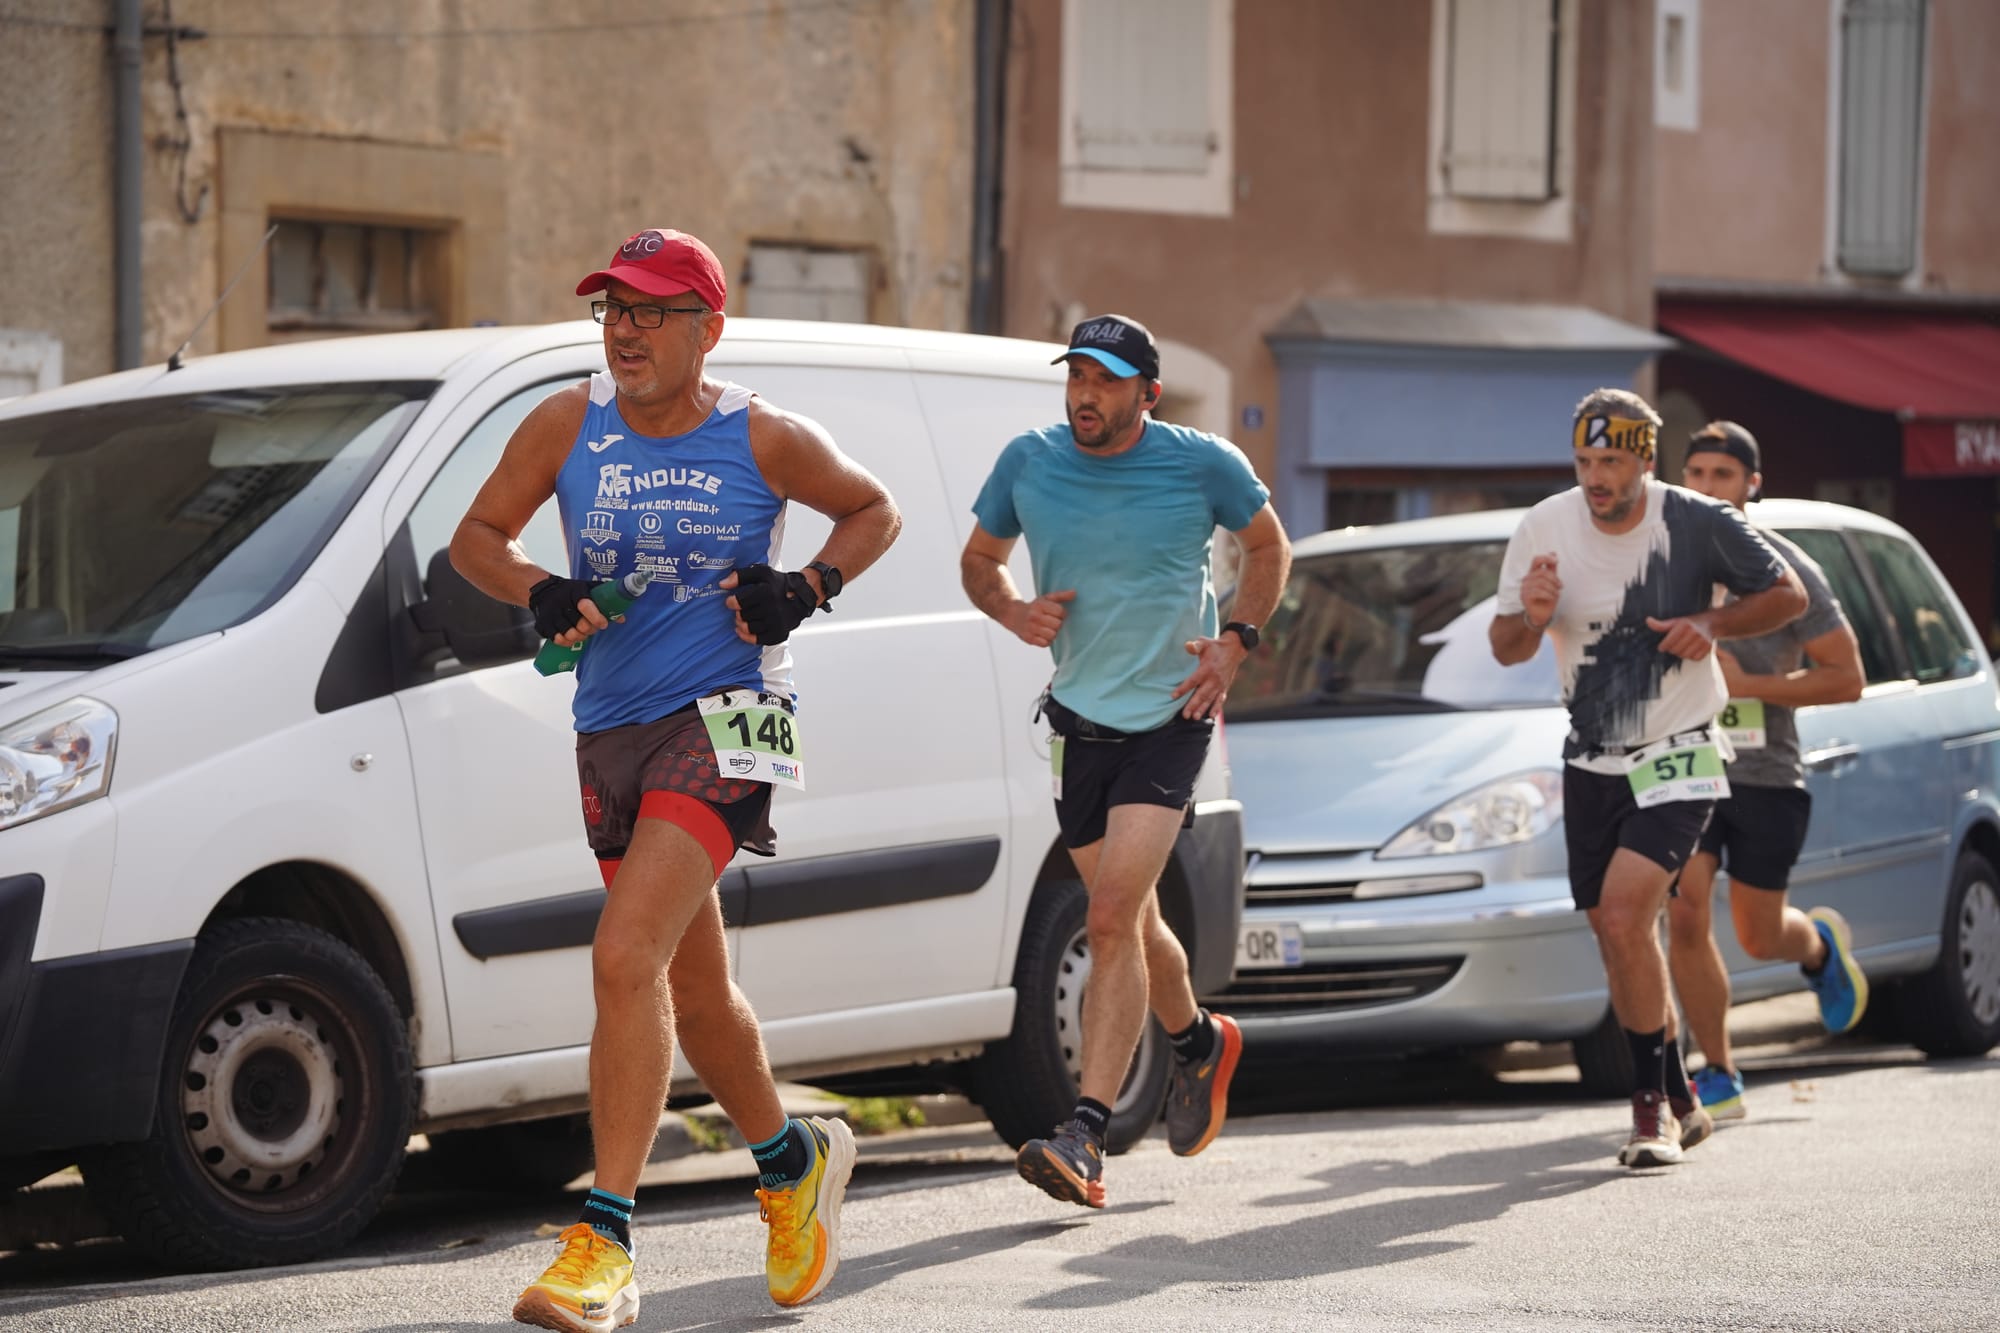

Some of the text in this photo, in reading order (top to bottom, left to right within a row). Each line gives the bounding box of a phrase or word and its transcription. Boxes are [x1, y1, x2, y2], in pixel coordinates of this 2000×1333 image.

[623, 236, 662, 252] CTC
[1076, 322, 1126, 344] TRAIL
[657, 556, 680, 566] BAT
[728, 712, 794, 755] 148
[1654, 751, 1696, 781] 57
